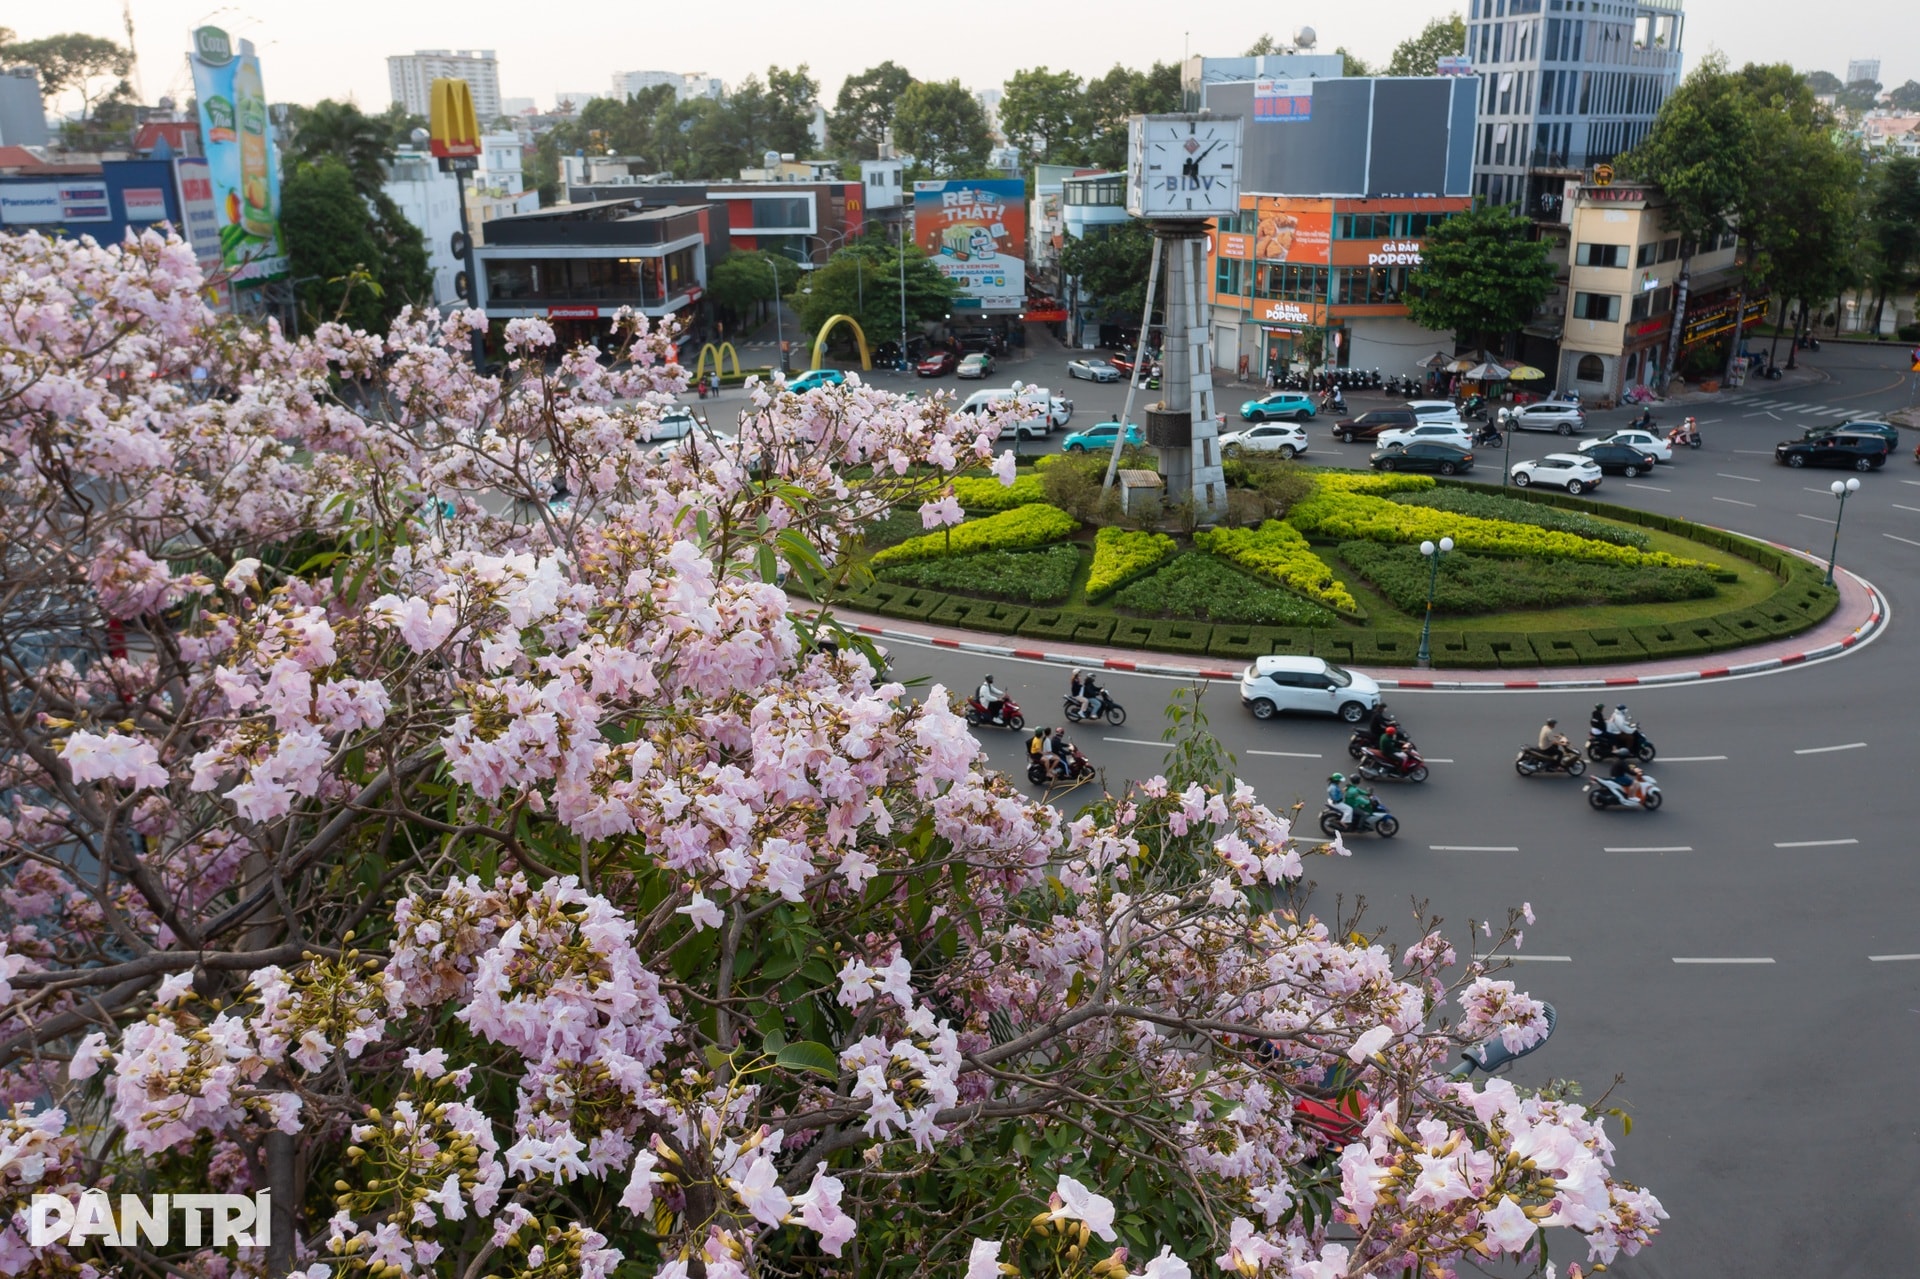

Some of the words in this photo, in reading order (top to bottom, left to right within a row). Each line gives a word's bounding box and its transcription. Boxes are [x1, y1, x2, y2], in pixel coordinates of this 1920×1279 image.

[201, 32, 229, 58] Cozy
[1166, 175, 1214, 191] BIDV
[2, 197, 57, 207] Panasonic
[1383, 241, 1397, 252] GÀ
[1398, 240, 1419, 252] RÁN
